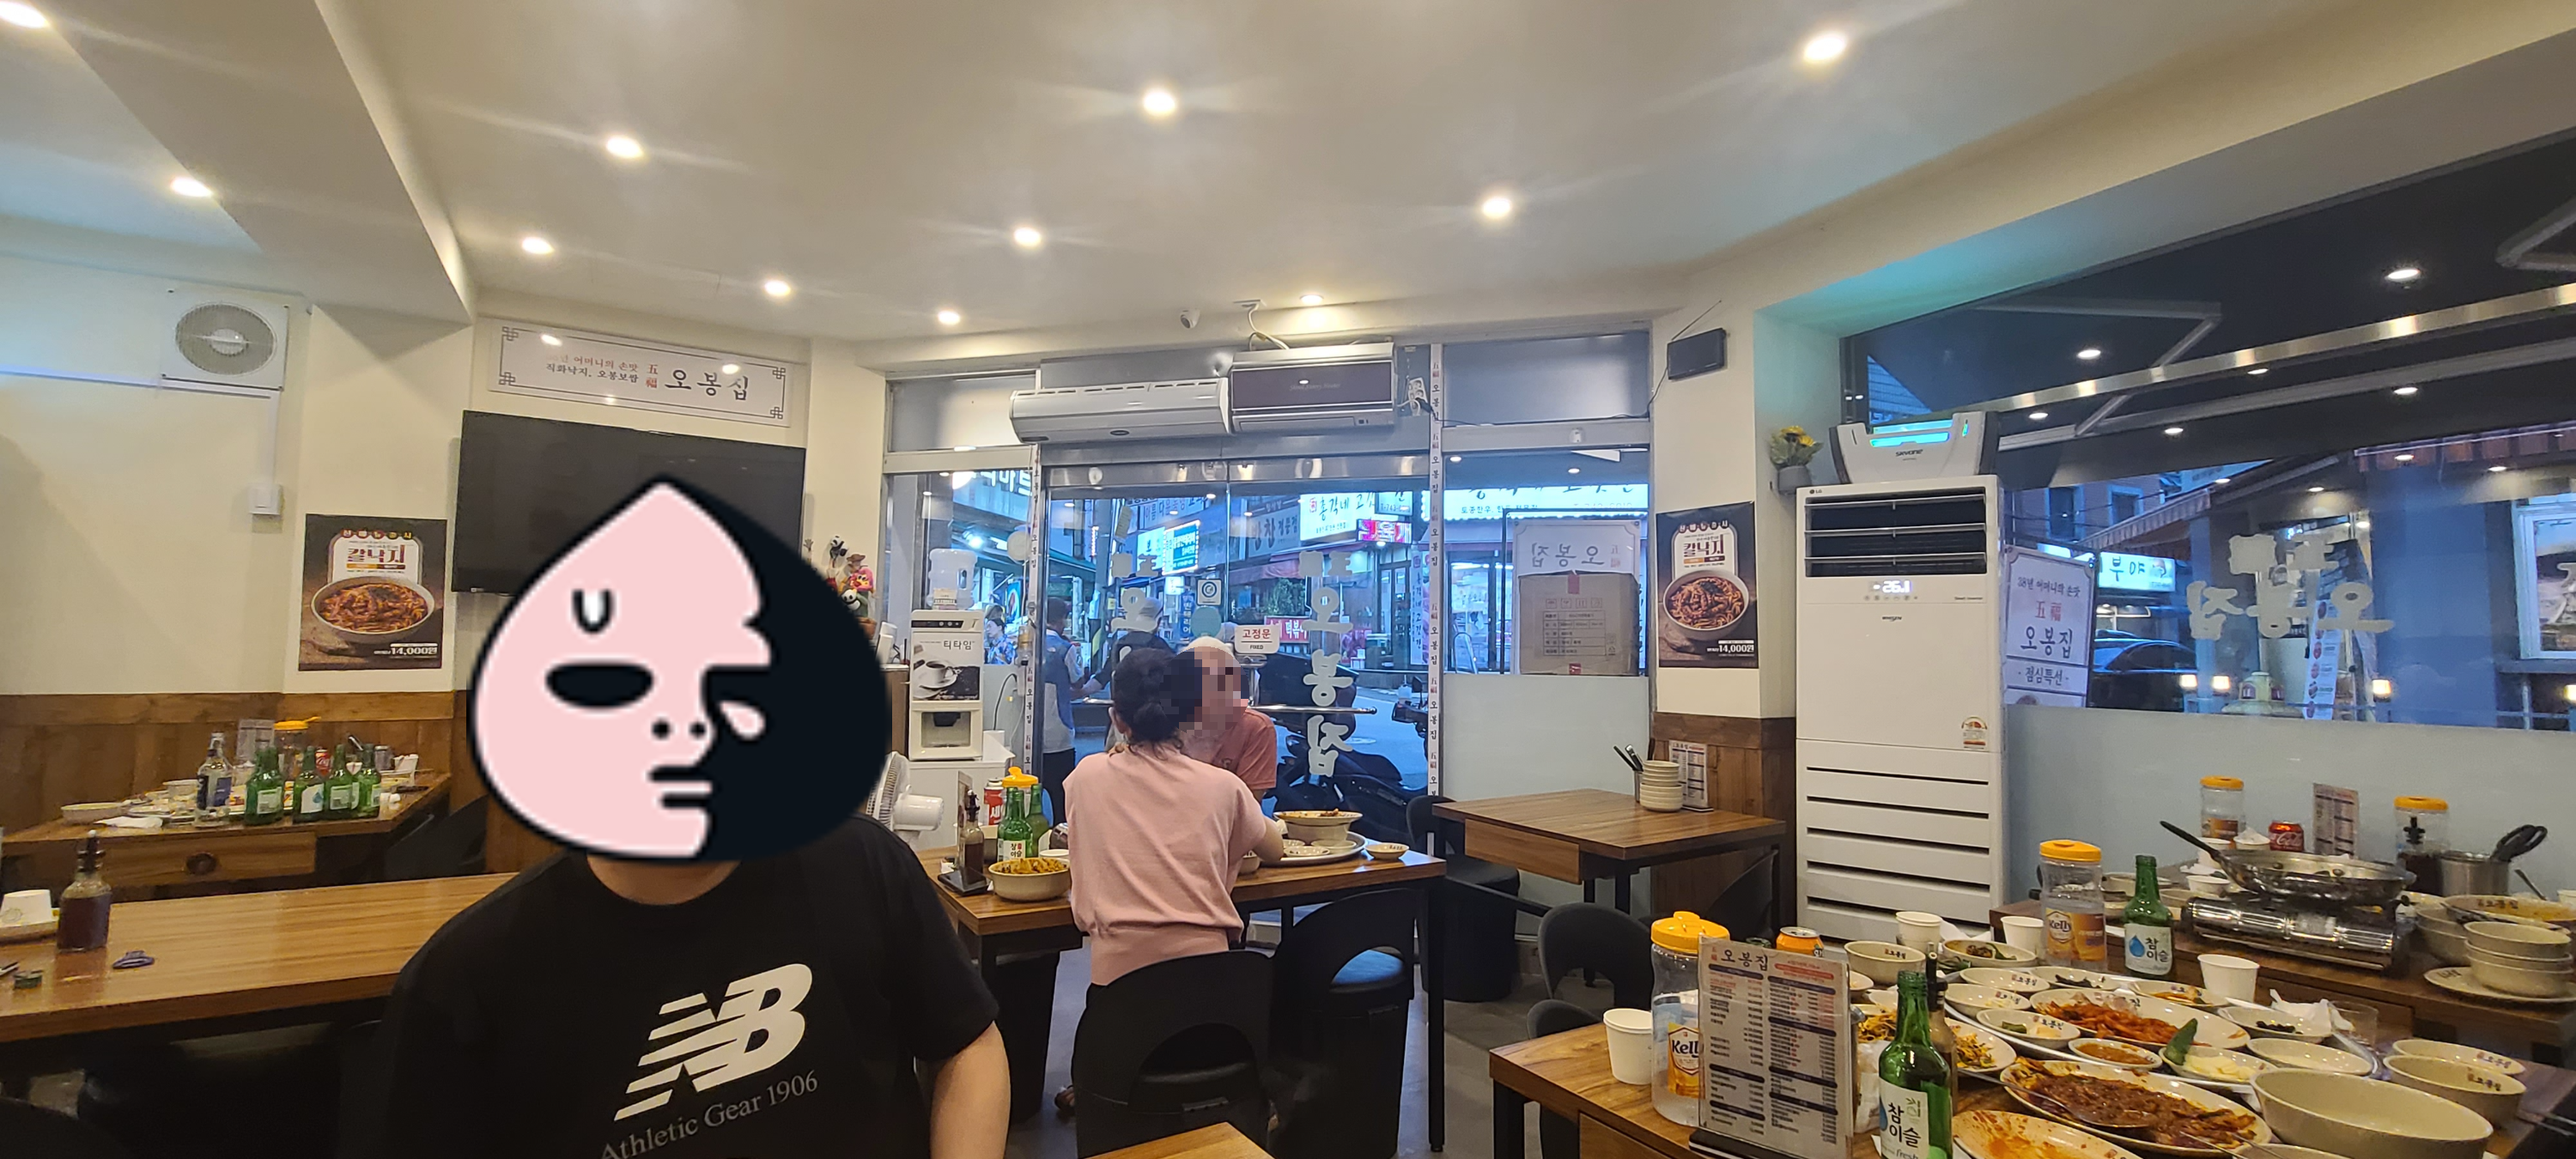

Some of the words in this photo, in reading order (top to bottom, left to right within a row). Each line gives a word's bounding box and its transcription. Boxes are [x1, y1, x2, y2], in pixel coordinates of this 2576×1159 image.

[574, 355, 615, 369] 어머니의
[597, 370, 639, 383] 오봉보쌈
[664, 368, 749, 401] 오봉집
[1319, 495, 1350, 522] 총각네
[1683, 534, 1725, 558] 칼낙지
[1242, 628, 1271, 640] 고정문
[2020, 625, 2074, 659] 오봉집
[390, 646, 438, 656] 14,000원
[943, 640, 972, 651] 티타임
[1718, 643, 1754, 653] 14,000원
[2024, 665, 2064, 687] 점심특선
[2049, 919, 2072, 933] Kelly
[2145, 937, 2160, 950] 참
[1720, 949, 1769, 972] 오봉집
[2146, 950, 2169, 963] 이슬
[1671, 1040, 1700, 1059] Kell
[600, 1116, 700, 1159] Athletic
[703, 1093, 762, 1128] Gear
[768, 1070, 819, 1107] 1906
[1887, 1101, 1905, 1125] 참
[1889, 1125, 1922, 1149] 이슬
